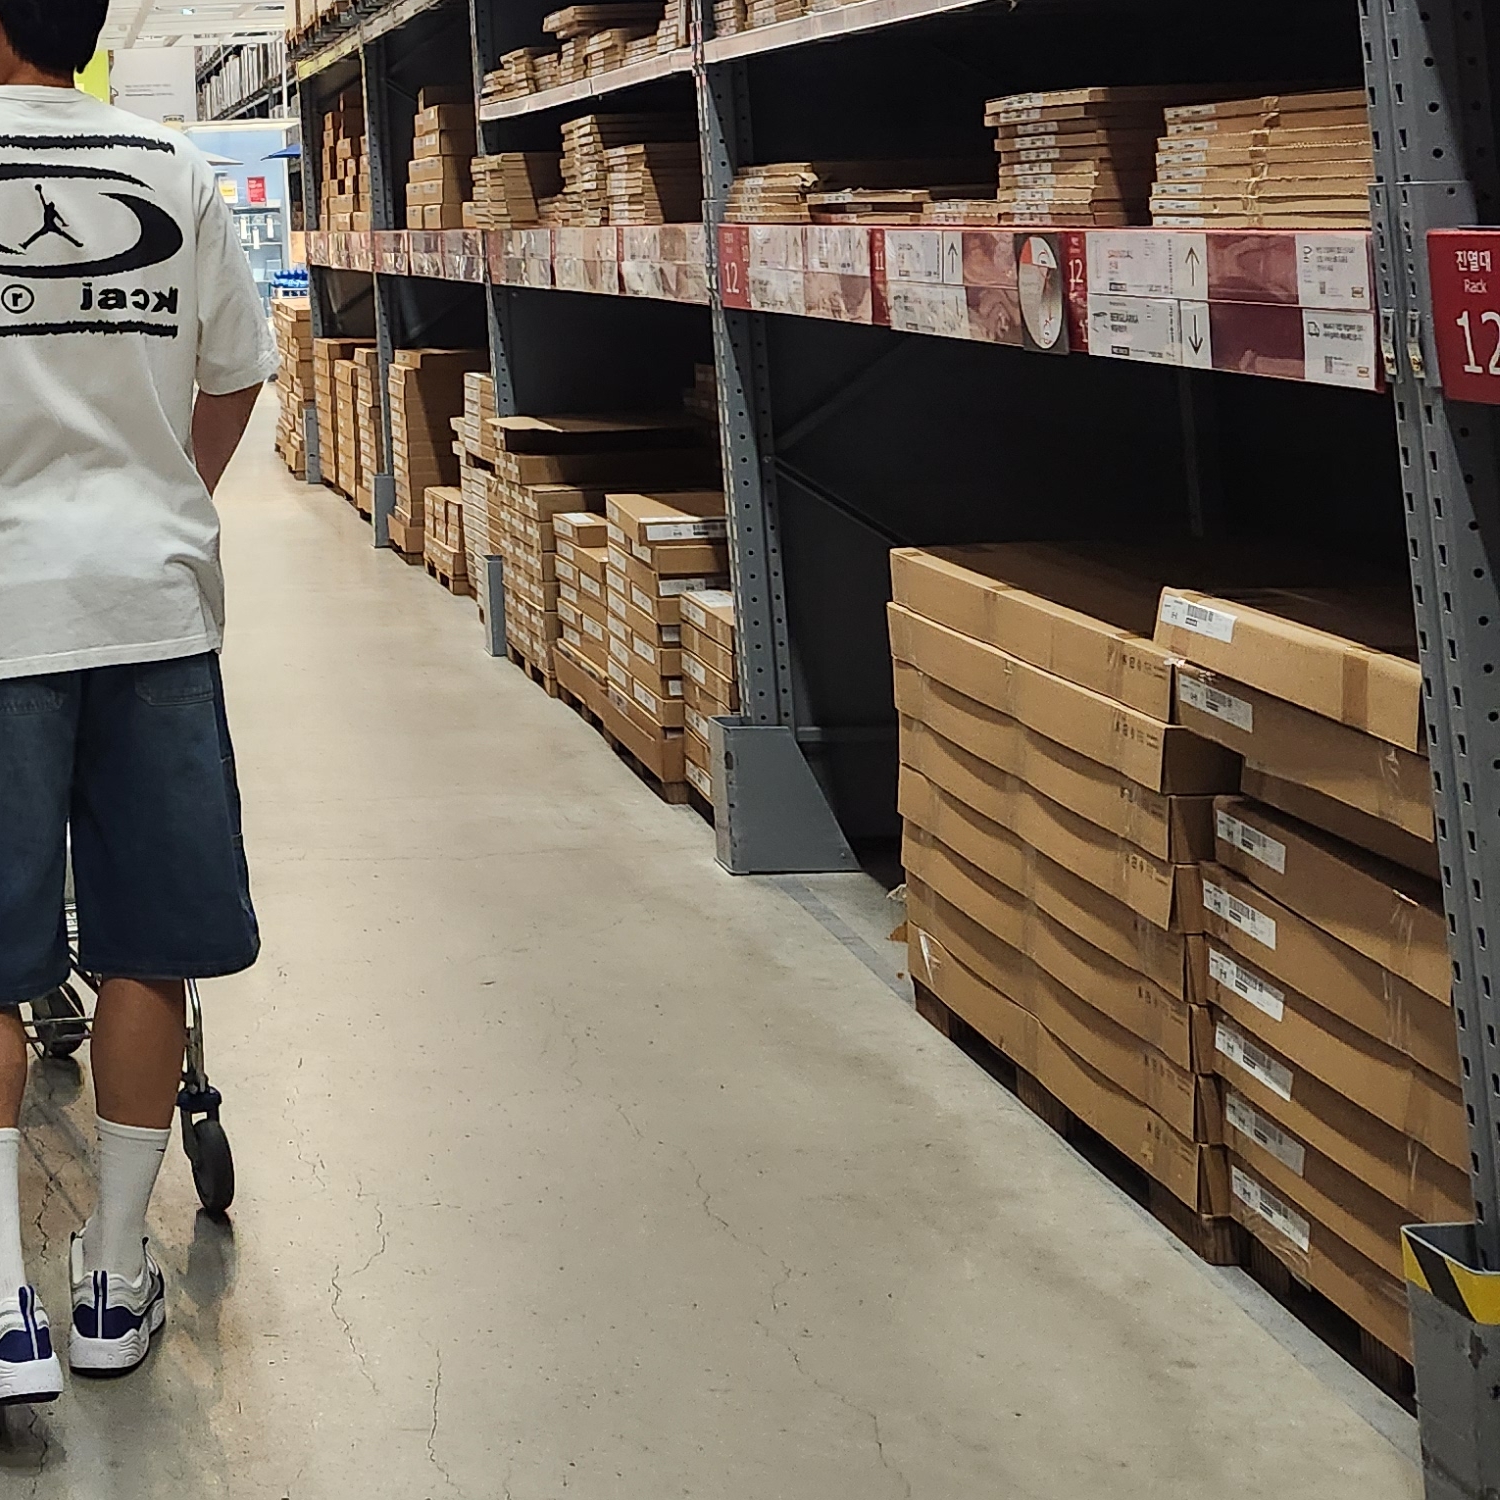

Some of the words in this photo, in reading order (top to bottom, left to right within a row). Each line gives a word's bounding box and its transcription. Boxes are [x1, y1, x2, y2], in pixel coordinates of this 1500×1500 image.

[1068, 258, 1084, 284] 12
[1455, 250, 1492, 273] 진열대
[724, 262, 740, 294] 12
[1463, 278, 1488, 294] Rack
